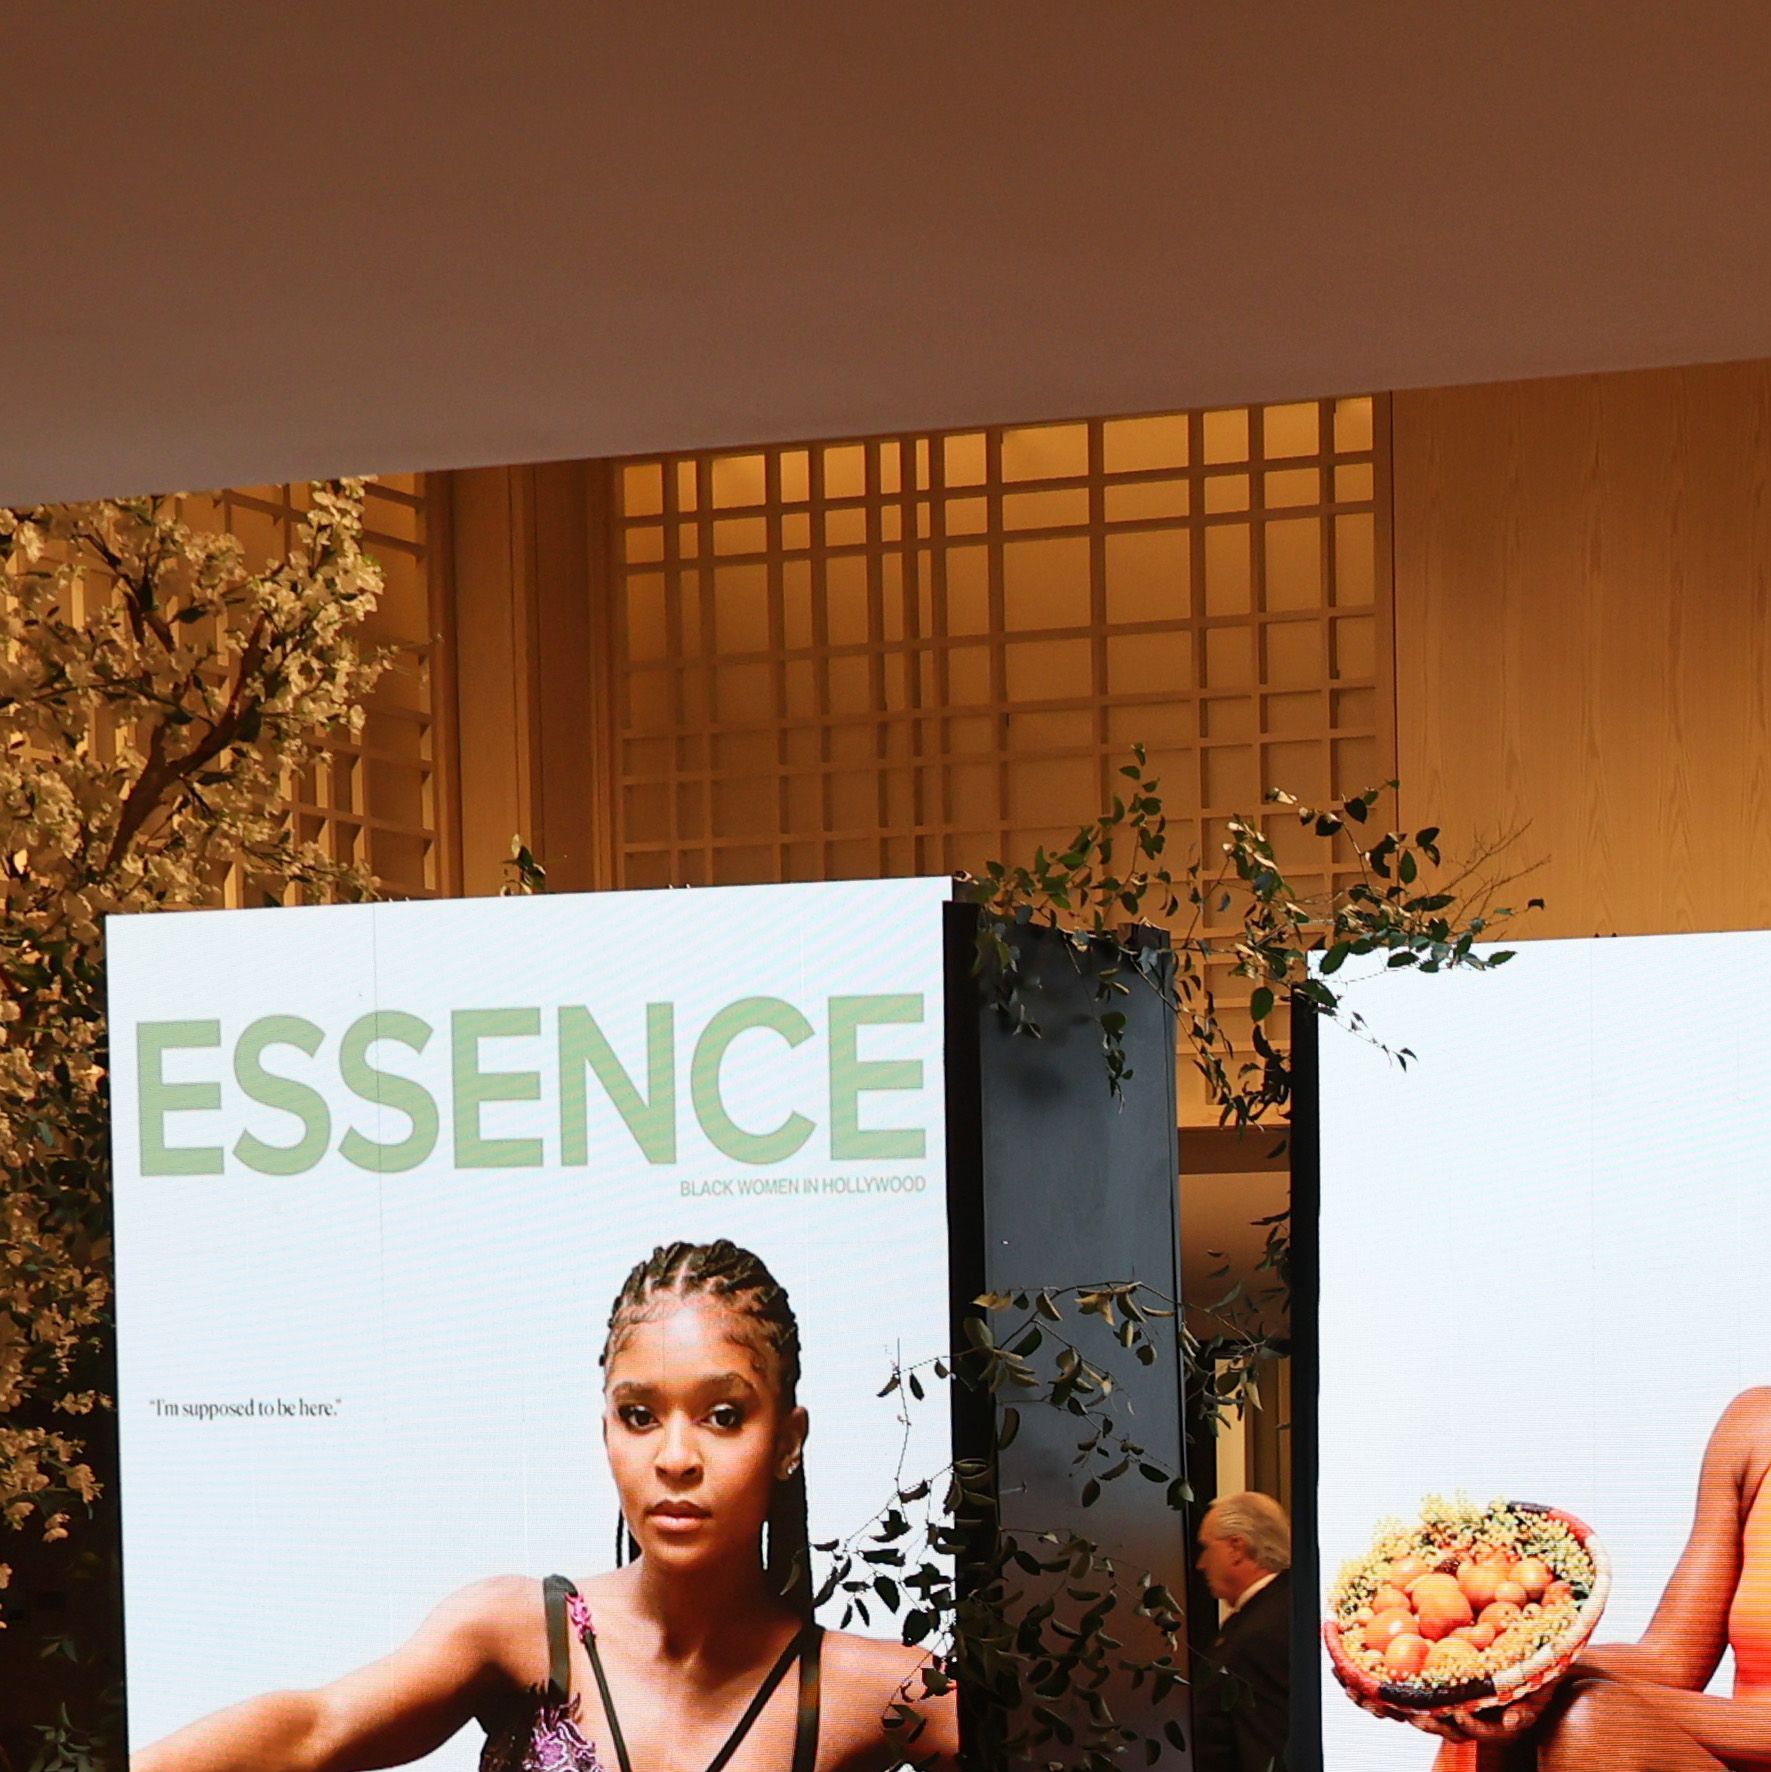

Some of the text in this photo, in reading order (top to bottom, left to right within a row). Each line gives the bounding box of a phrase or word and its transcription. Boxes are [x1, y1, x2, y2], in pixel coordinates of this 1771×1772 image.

[136, 993, 927, 1177] ESSENCE
[680, 1175, 927, 1197] BLACK WOMEN IN HOLLYWOOD
[182, 1398, 255, 1421] supposed
[258, 1401, 275, 1417] to
[277, 1398, 296, 1417] be
